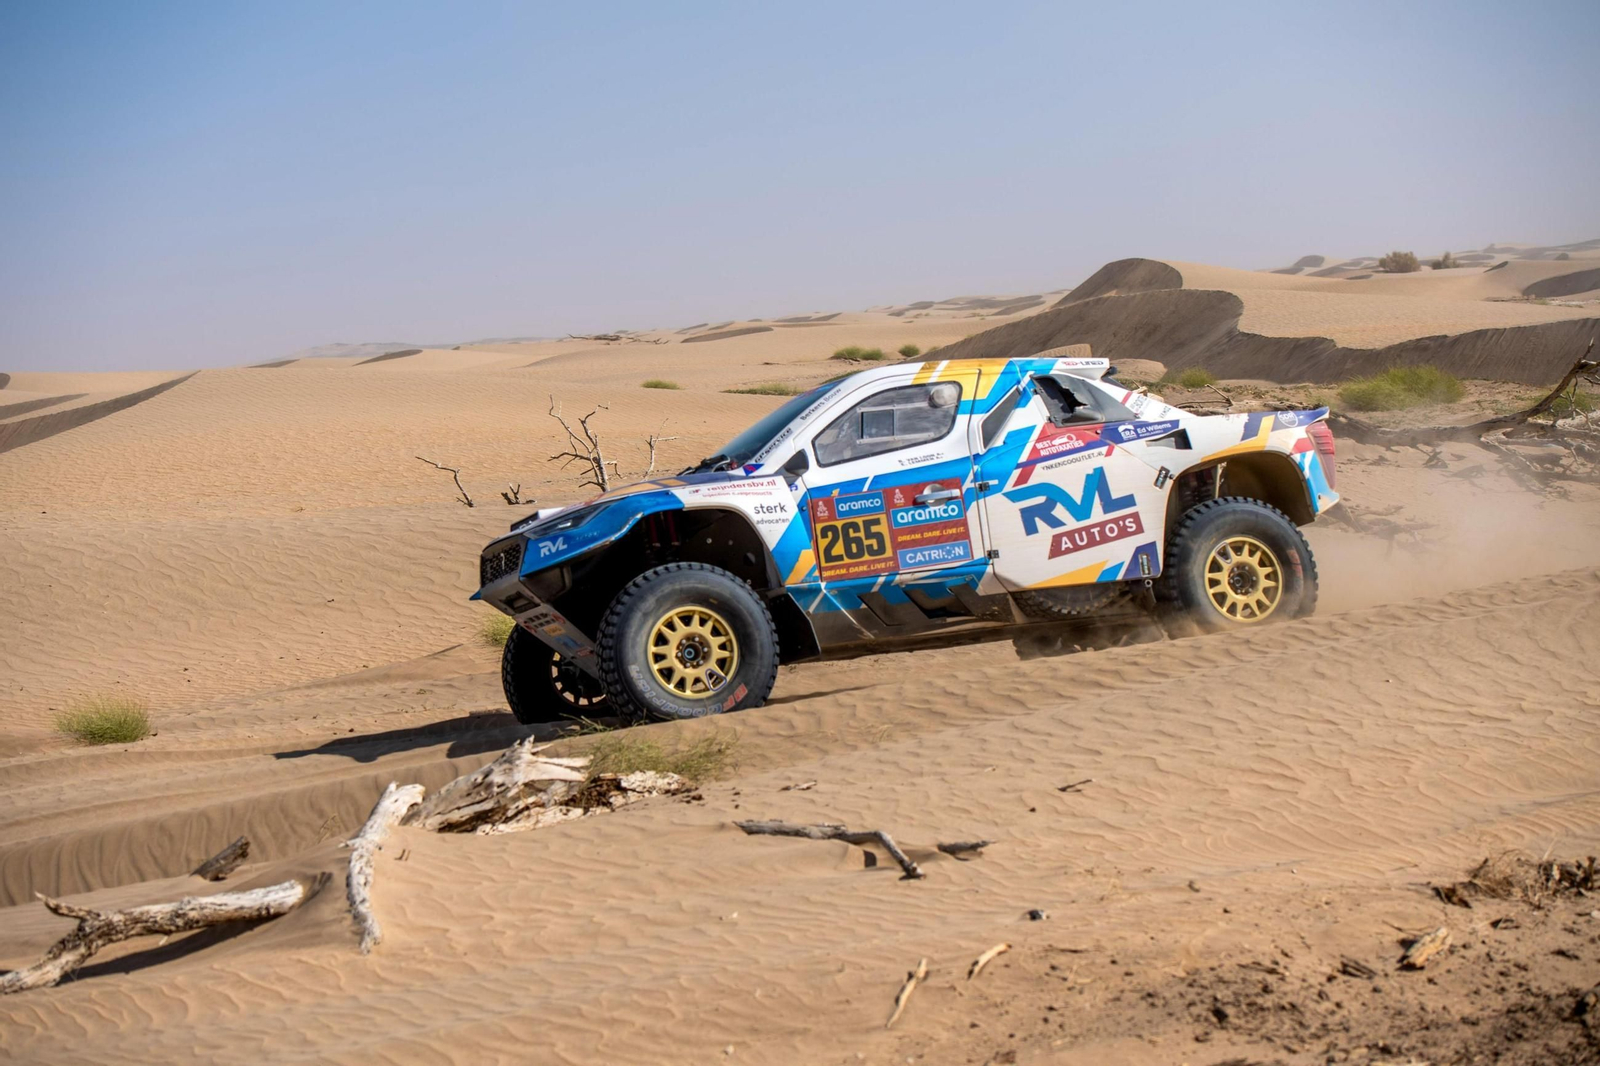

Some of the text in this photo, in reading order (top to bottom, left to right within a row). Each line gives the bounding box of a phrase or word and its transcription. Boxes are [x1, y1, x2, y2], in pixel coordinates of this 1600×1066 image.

[1146, 423, 1172, 432] Willems
[1035, 440, 1052, 449] BEST
[1040, 439, 1085, 457] AUTOTAXATIES
[754, 502, 788, 514] sterk
[838, 498, 881, 511] aramco
[1002, 466, 1137, 536] RVL
[897, 504, 959, 523] aramco
[820, 518, 887, 564] 265
[897, 533, 922, 542] DREAM.
[924, 530, 943, 538] DARE.
[1061, 518, 1137, 551] AUTO'S
[538, 536, 568, 557] RVL
[822, 568, 848, 577] DREAM.
[849, 565, 870, 573] DARE.
[871, 562, 886, 570] LIVE
